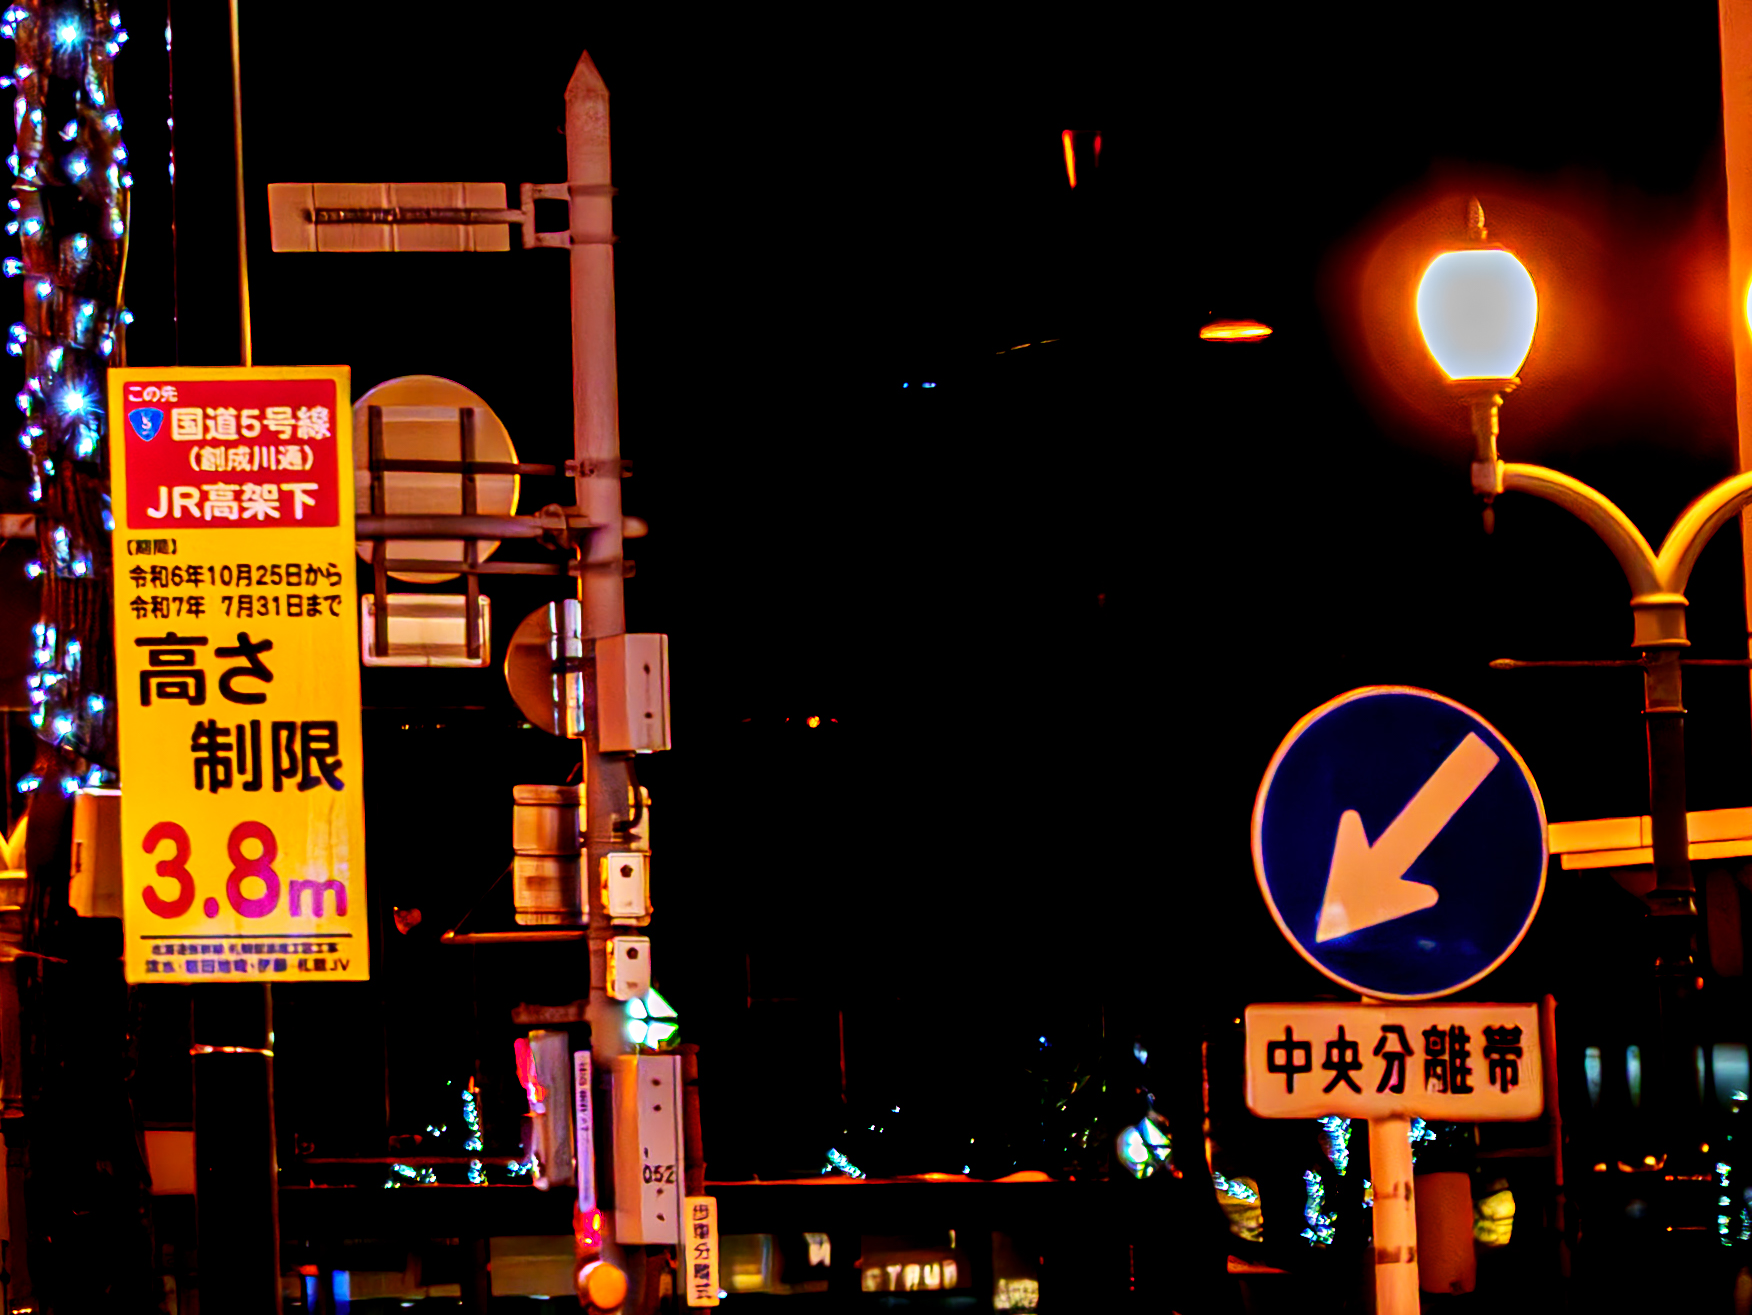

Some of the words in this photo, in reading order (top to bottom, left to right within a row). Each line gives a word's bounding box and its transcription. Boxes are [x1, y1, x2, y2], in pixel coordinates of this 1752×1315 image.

[128, 385, 179, 403] この先
[170, 405, 332, 442] 国道5号線
[146, 481, 319, 521] JR高架下
[129, 562, 343, 589] 令和6年10月25日から
[129, 595, 206, 619] 令和7年
[221, 594, 343, 618] 7月31日まで
[134, 632, 275, 708] 高さ
[189, 719, 345, 795] 制限
[141, 820, 348, 920] 3.8m
[1266, 1023, 1524, 1096] 中央分離帯
